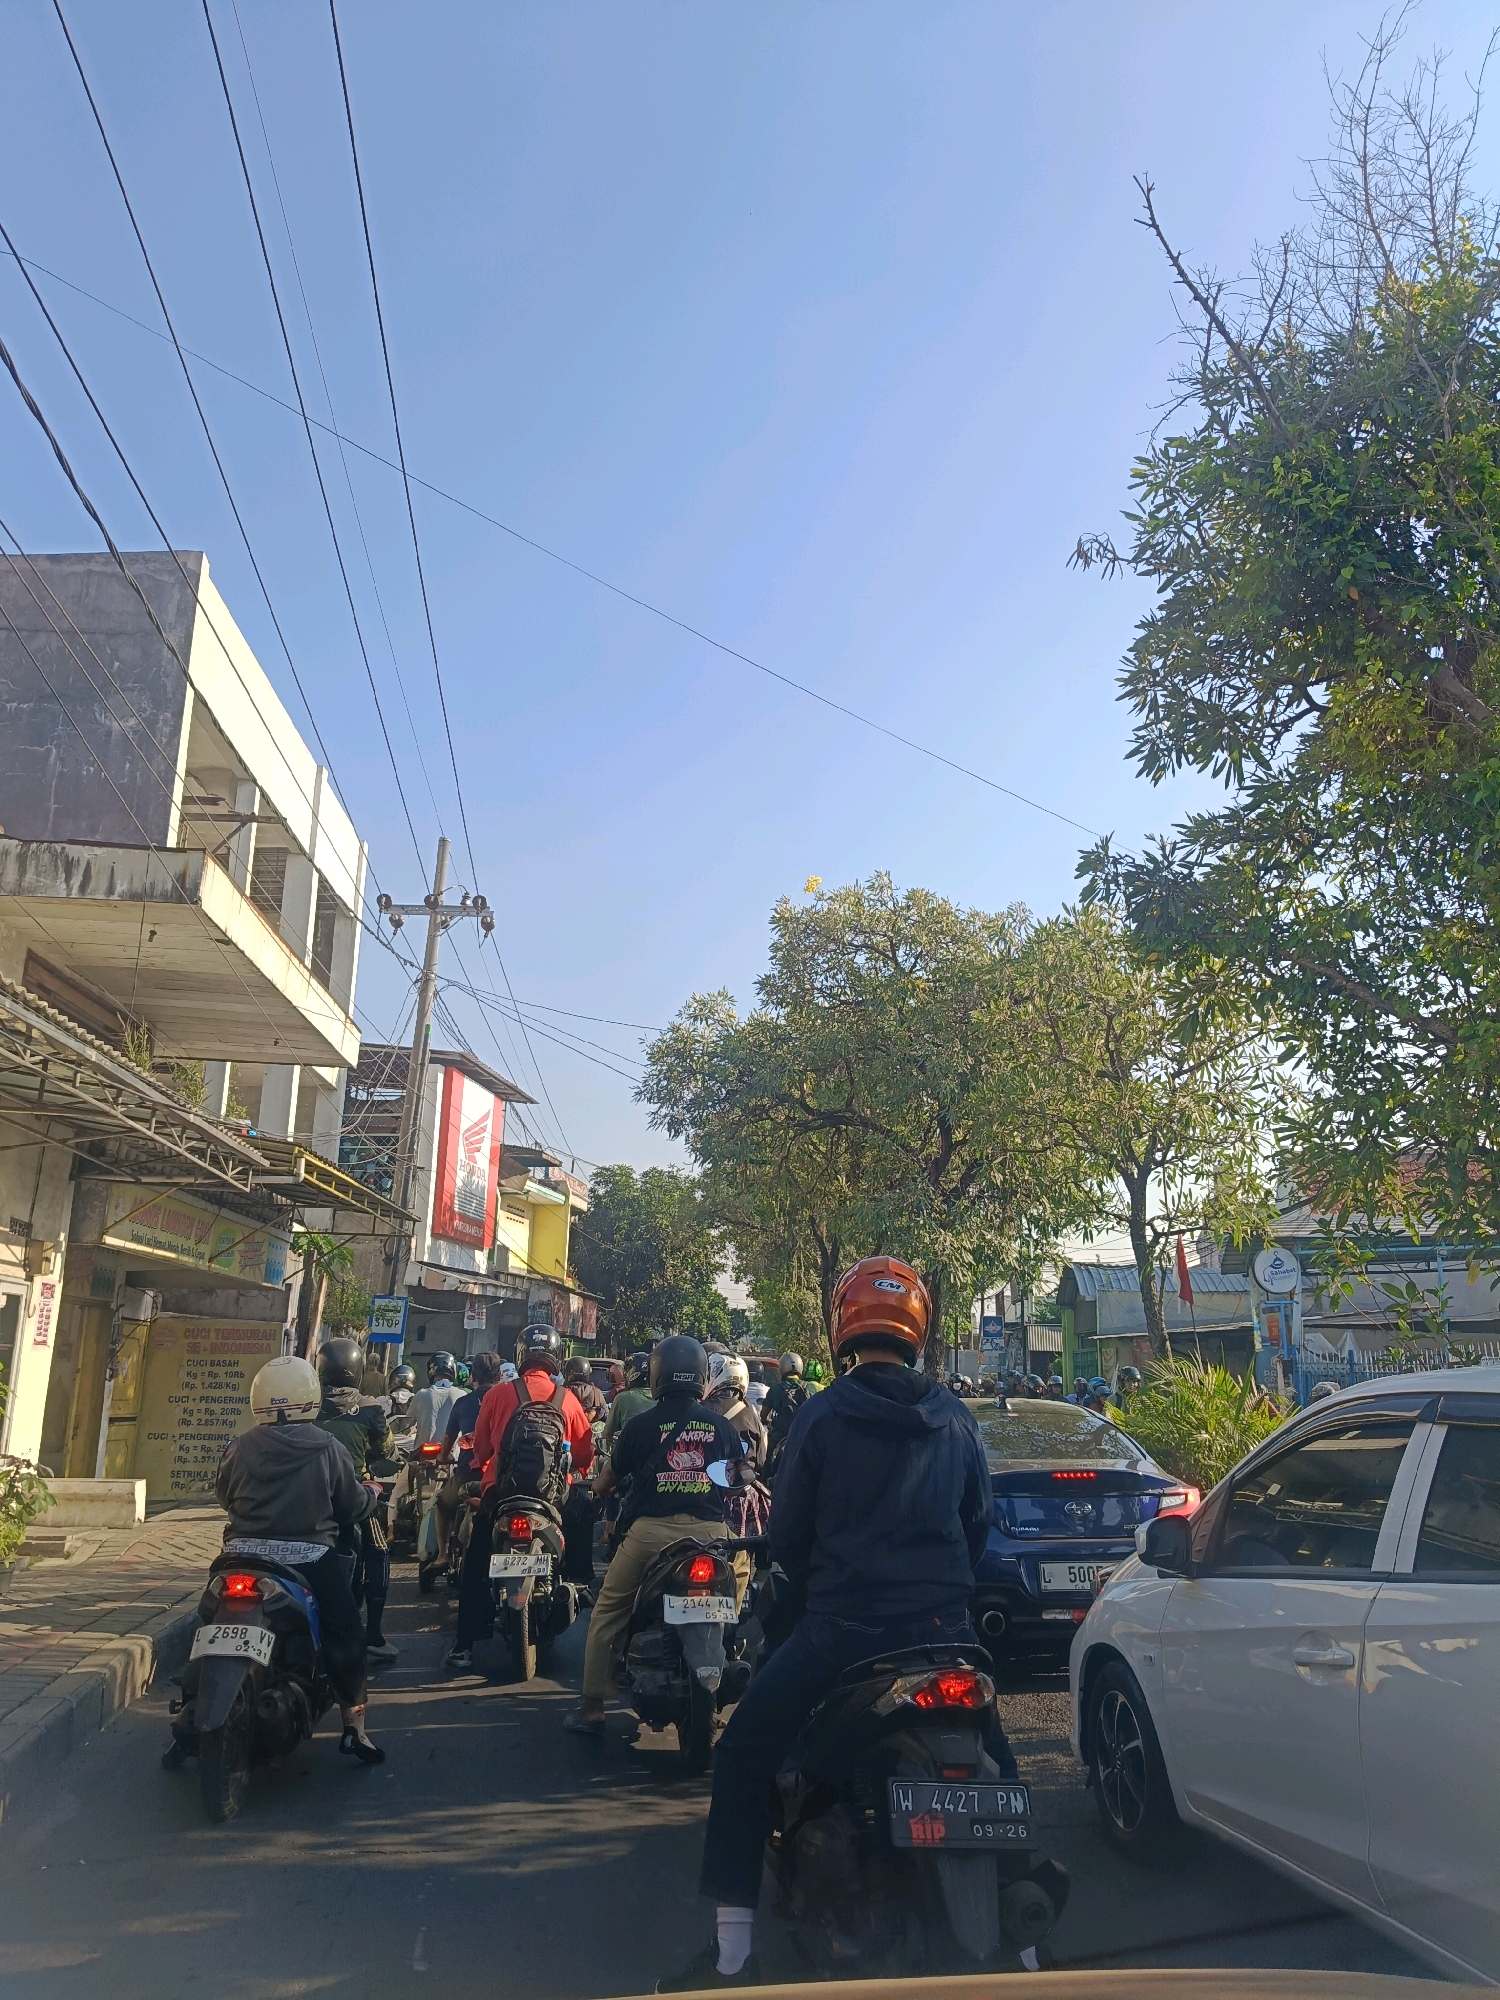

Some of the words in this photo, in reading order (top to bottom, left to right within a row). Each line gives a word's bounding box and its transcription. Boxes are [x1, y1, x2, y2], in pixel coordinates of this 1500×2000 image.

[459, 1159, 486, 1182] HONDA
[1270, 1268, 1297, 1276] Sahabat
[375, 1317, 400, 1328] STOP
[184, 1327, 211, 1340] CUCI
[214, 1327, 277, 1341] TERMURAH
[185, 1341, 202, 1354] SE
[209, 1342, 273, 1355] INDONESIA
[186, 1359, 208, 1367] CUCI
[209, 1359, 240, 1368] BASAH
[186, 1370, 198, 1380] Kg
[207, 1370, 221, 1380] Rp.
[224, 1371, 245, 1379] 10Rb
[181, 1382, 198, 1391] (Rp.
[201, 1382, 240, 1392] 1.428/Kg)
[168, 1395, 190, 1404] CUCI
[199, 1395, 251, 1404] PENGERING
[182, 1407, 194, 1417] Kg
[204, 1407, 218, 1417] Rp.
[220, 1407, 242, 1416] 20Rb
[177, 1418, 194, 1428] (Rp.
[196, 1418, 237, 1428] 2.857/Kg)
[147, 1432, 169, 1441] CUCI
[178, 1433, 230, 1441] PENGERING
[178, 1444, 191, 1454] Kg
[200, 1444, 214, 1454] Rp.
[173, 1455, 190, 1465] (Rp.
[170, 1470, 208, 1479] SETRIKA
[656, 1472, 680, 1482] YANG
[679, 1470, 710, 1483] NGUTAN
[492, 1556, 498, 1566] L
[1041, 1566, 1052, 1584] L
[668, 1597, 675, 1609] L
[683, 1598, 711, 1609] 2144
[718, 1598, 733, 1610] KL
[195, 1629, 202, 1643] L
[212, 1625, 249, 1640] 2698
[898, 1788, 913, 1812] W
[931, 1789, 979, 1813] 4427
[910, 1822, 946, 1843] RIP
